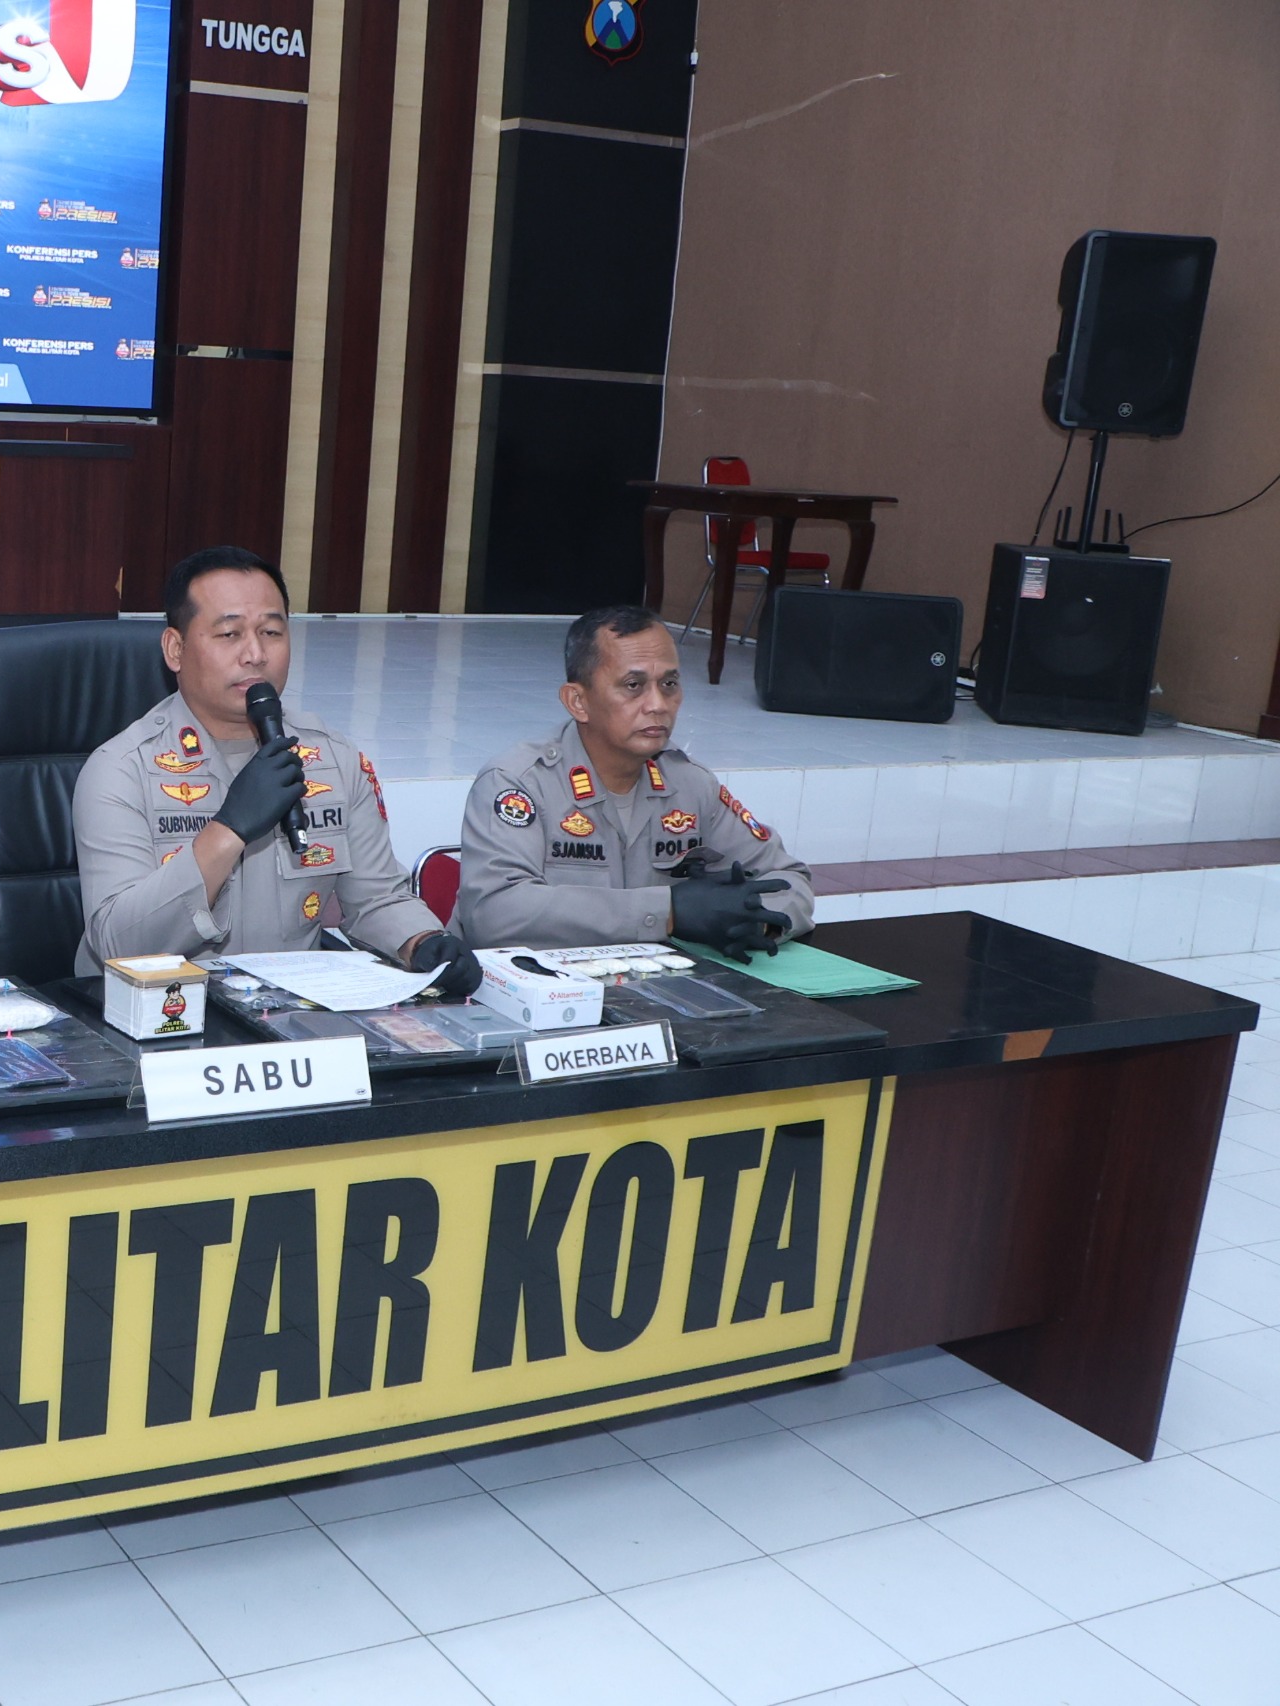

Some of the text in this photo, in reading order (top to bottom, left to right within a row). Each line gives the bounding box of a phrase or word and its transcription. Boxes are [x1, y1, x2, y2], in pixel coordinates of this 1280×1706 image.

[201, 18, 306, 58] TUNGGA
[7, 245, 98, 259] KONFERENSI PERS
[67, 256, 84, 264] KOTA
[3, 338, 94, 351] KONFERENSI PERS
[158, 815, 212, 833] SUBIYANTA
[303, 807, 342, 830] LRI
[297, 829, 308, 845] 9
[556, 991, 584, 1000] Altamed
[544, 1042, 655, 1071] OKERBAYA
[203, 1057, 313, 1096] SABU
[470, 1118, 825, 1374] KOTA
